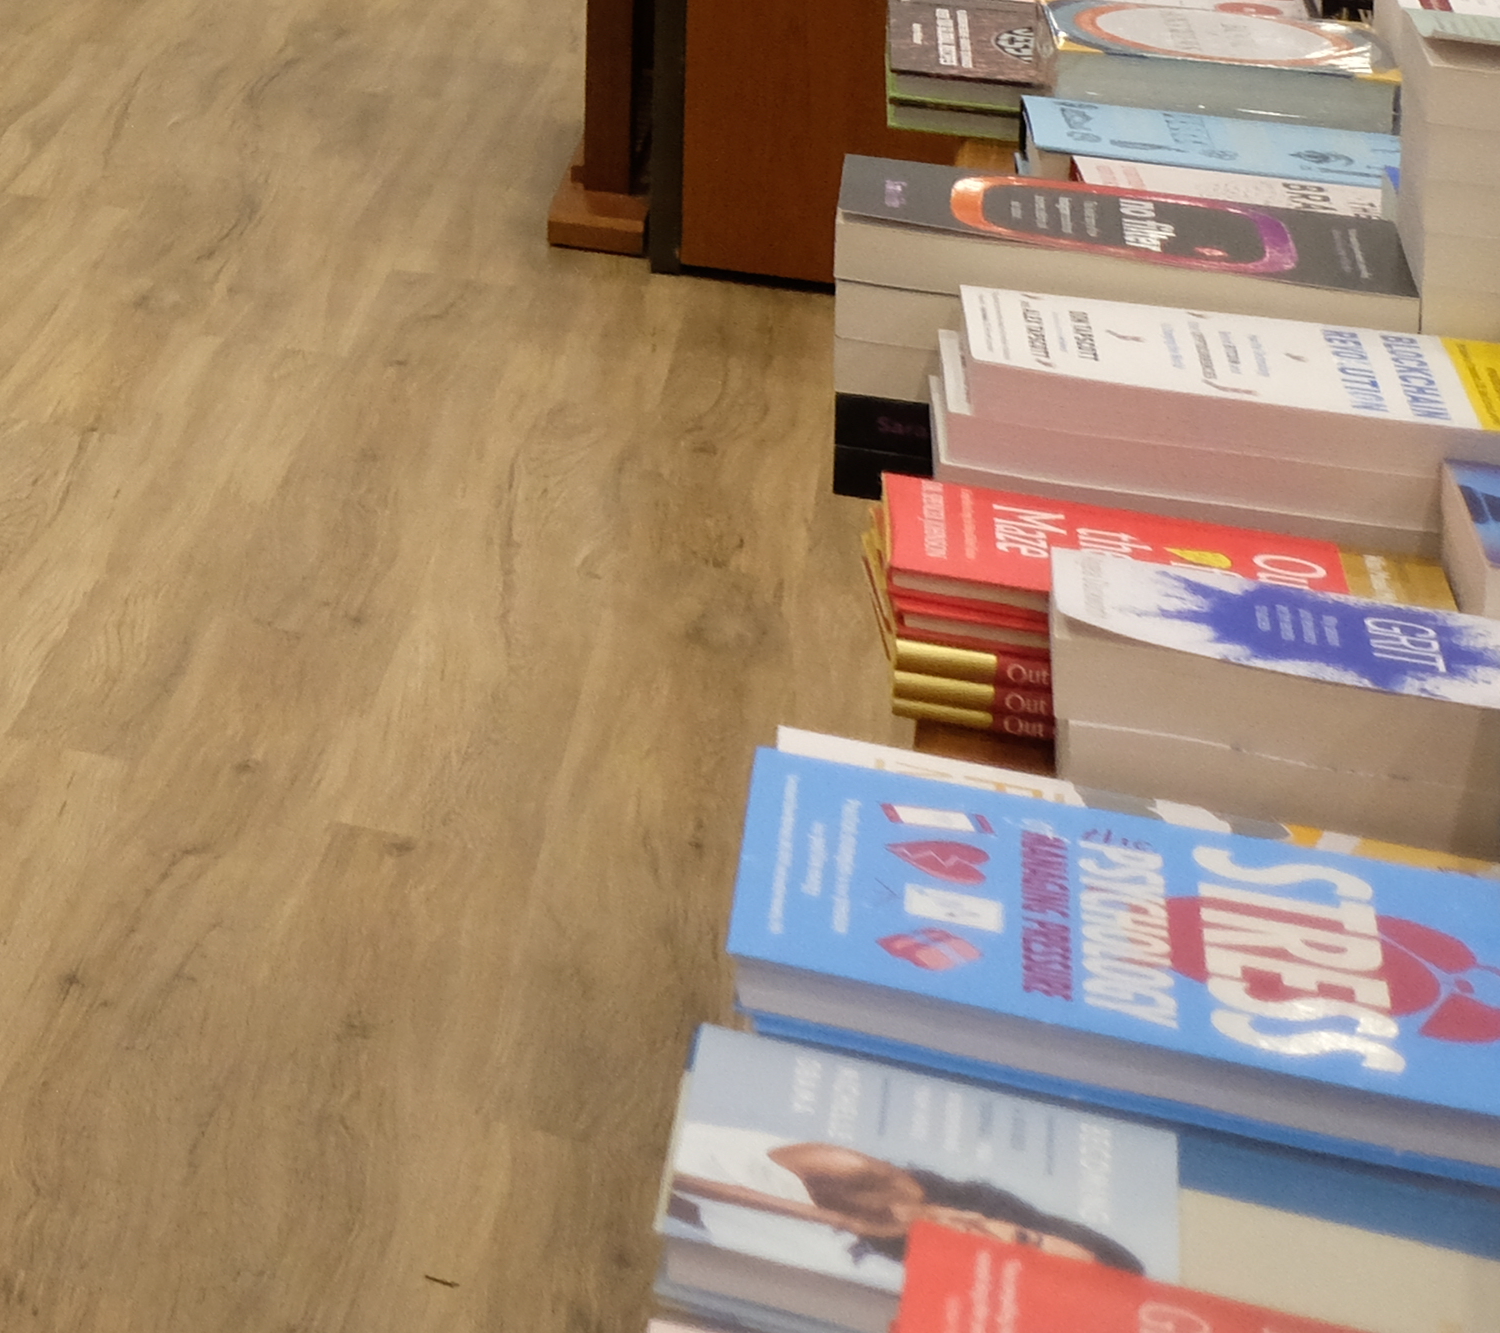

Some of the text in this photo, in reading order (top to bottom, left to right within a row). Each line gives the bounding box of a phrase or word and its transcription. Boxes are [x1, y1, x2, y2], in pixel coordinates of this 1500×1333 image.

[1119, 199, 1177, 253] no filter
[1392, 333, 1452, 421] BLOCKCHAIN
[991, 502, 1067, 559] Maze
[1363, 617, 1446, 674] GRIT
[1020, 829, 1075, 1003] MANAGING PRESSURE
[1077, 840, 1182, 1030] PSYCHOLOGY
[1191, 843, 1408, 1076] STRESS
